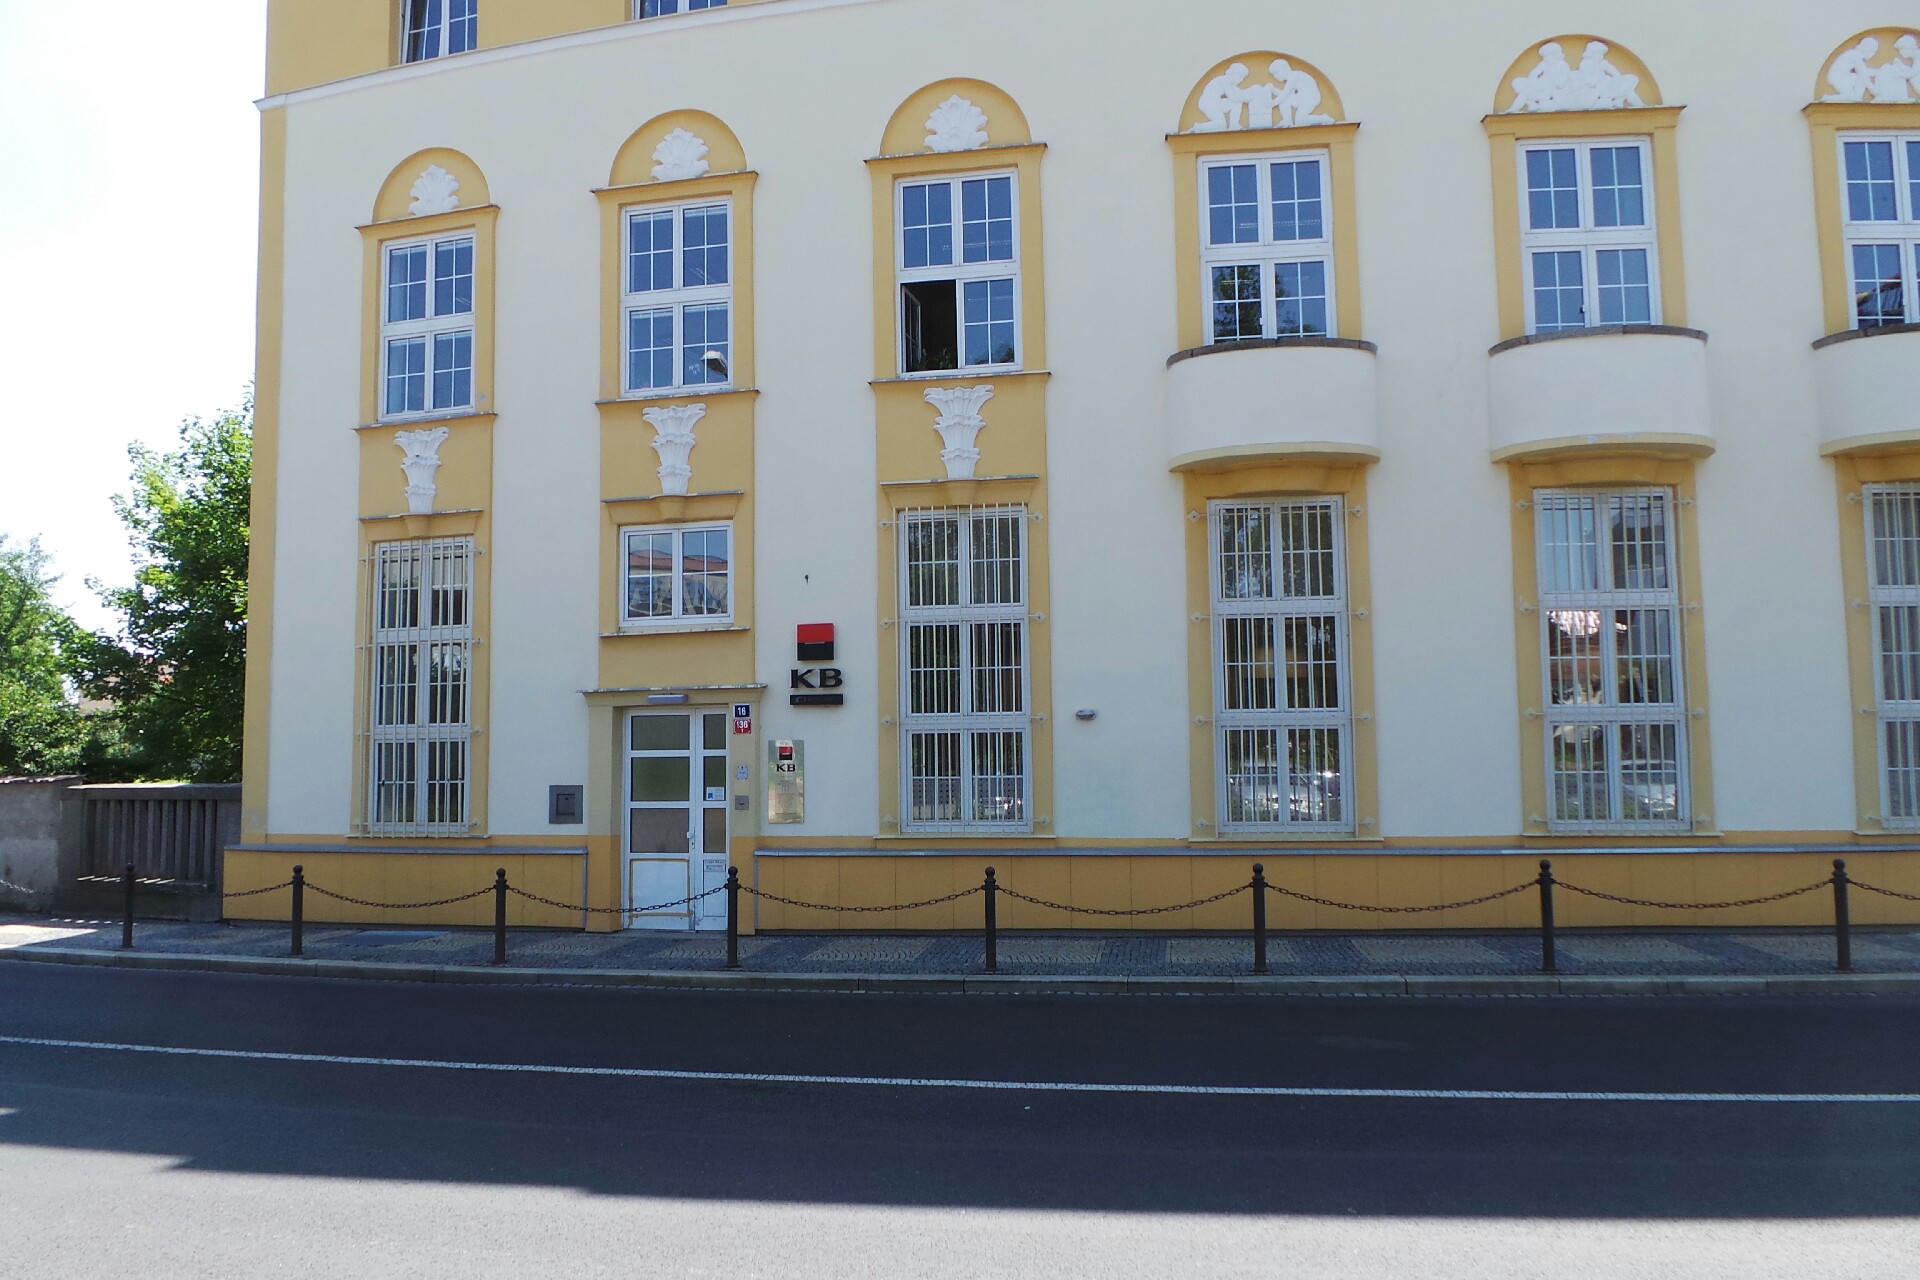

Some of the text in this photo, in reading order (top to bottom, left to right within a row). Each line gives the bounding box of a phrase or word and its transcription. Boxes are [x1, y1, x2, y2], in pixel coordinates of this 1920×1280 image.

[791, 668, 843, 689] KB
[737, 706, 746, 716] 16
[776, 763, 796, 772] KB
